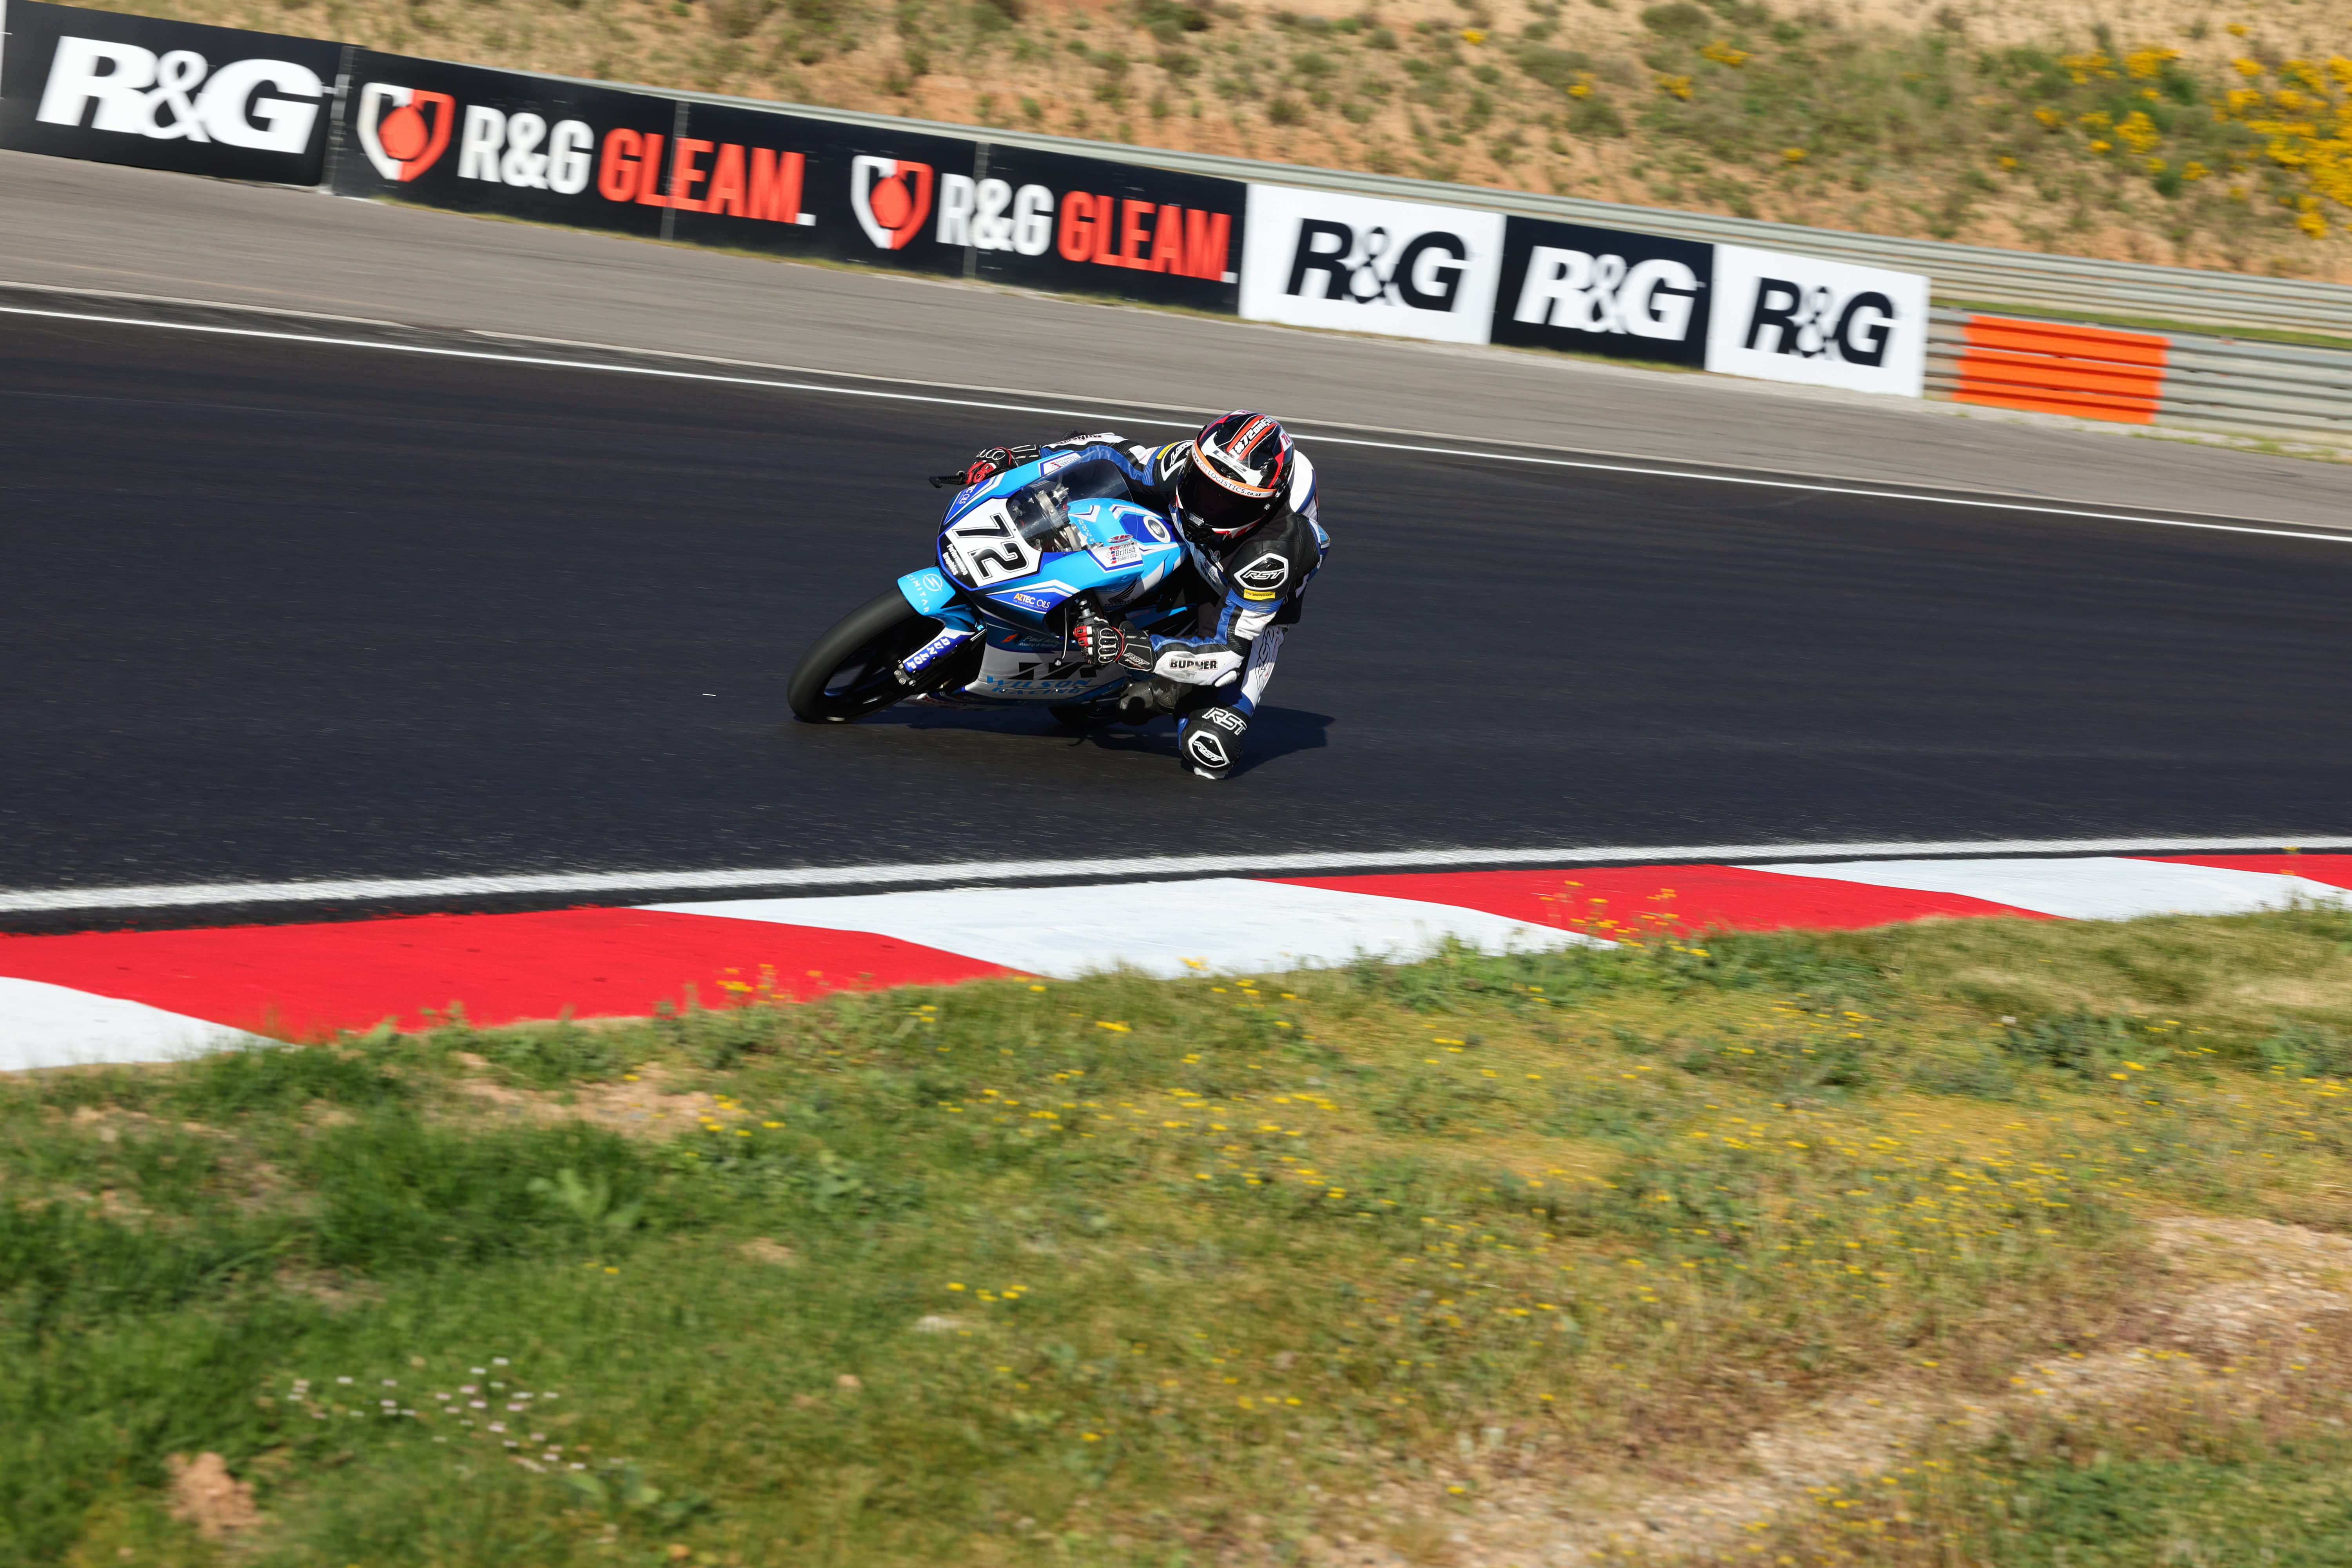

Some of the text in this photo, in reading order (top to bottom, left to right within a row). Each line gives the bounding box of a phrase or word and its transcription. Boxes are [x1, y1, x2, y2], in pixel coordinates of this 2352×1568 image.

[35, 35, 325, 154] R&G
[457, 104, 595, 195] R&G
[936, 173, 1055, 256] R&G
[1285, 216, 1473, 314] R&G
[1512, 245, 1706, 341] R&G
[1743, 276, 1898, 368] R&G
[1212, 450, 1247, 474] LS2
[959, 494, 970, 504] OILS
[946, 543, 968, 576] Performance
[952, 513, 1029, 580] 72
[1115, 546, 1136, 557] British
[942, 552, 959, 575] Graphics
[1242, 568, 1285, 580] RST
[906, 575, 929, 613] CIMITAR
[1013, 593, 1051, 609] AZTEC OILS
[907, 637, 951, 669] DUNLOP
[1123, 652, 1151, 665] RST
[986, 675, 1093, 688] WILSON
[1201, 707, 1247, 736] RST
[1192, 740, 1224, 762] RST
